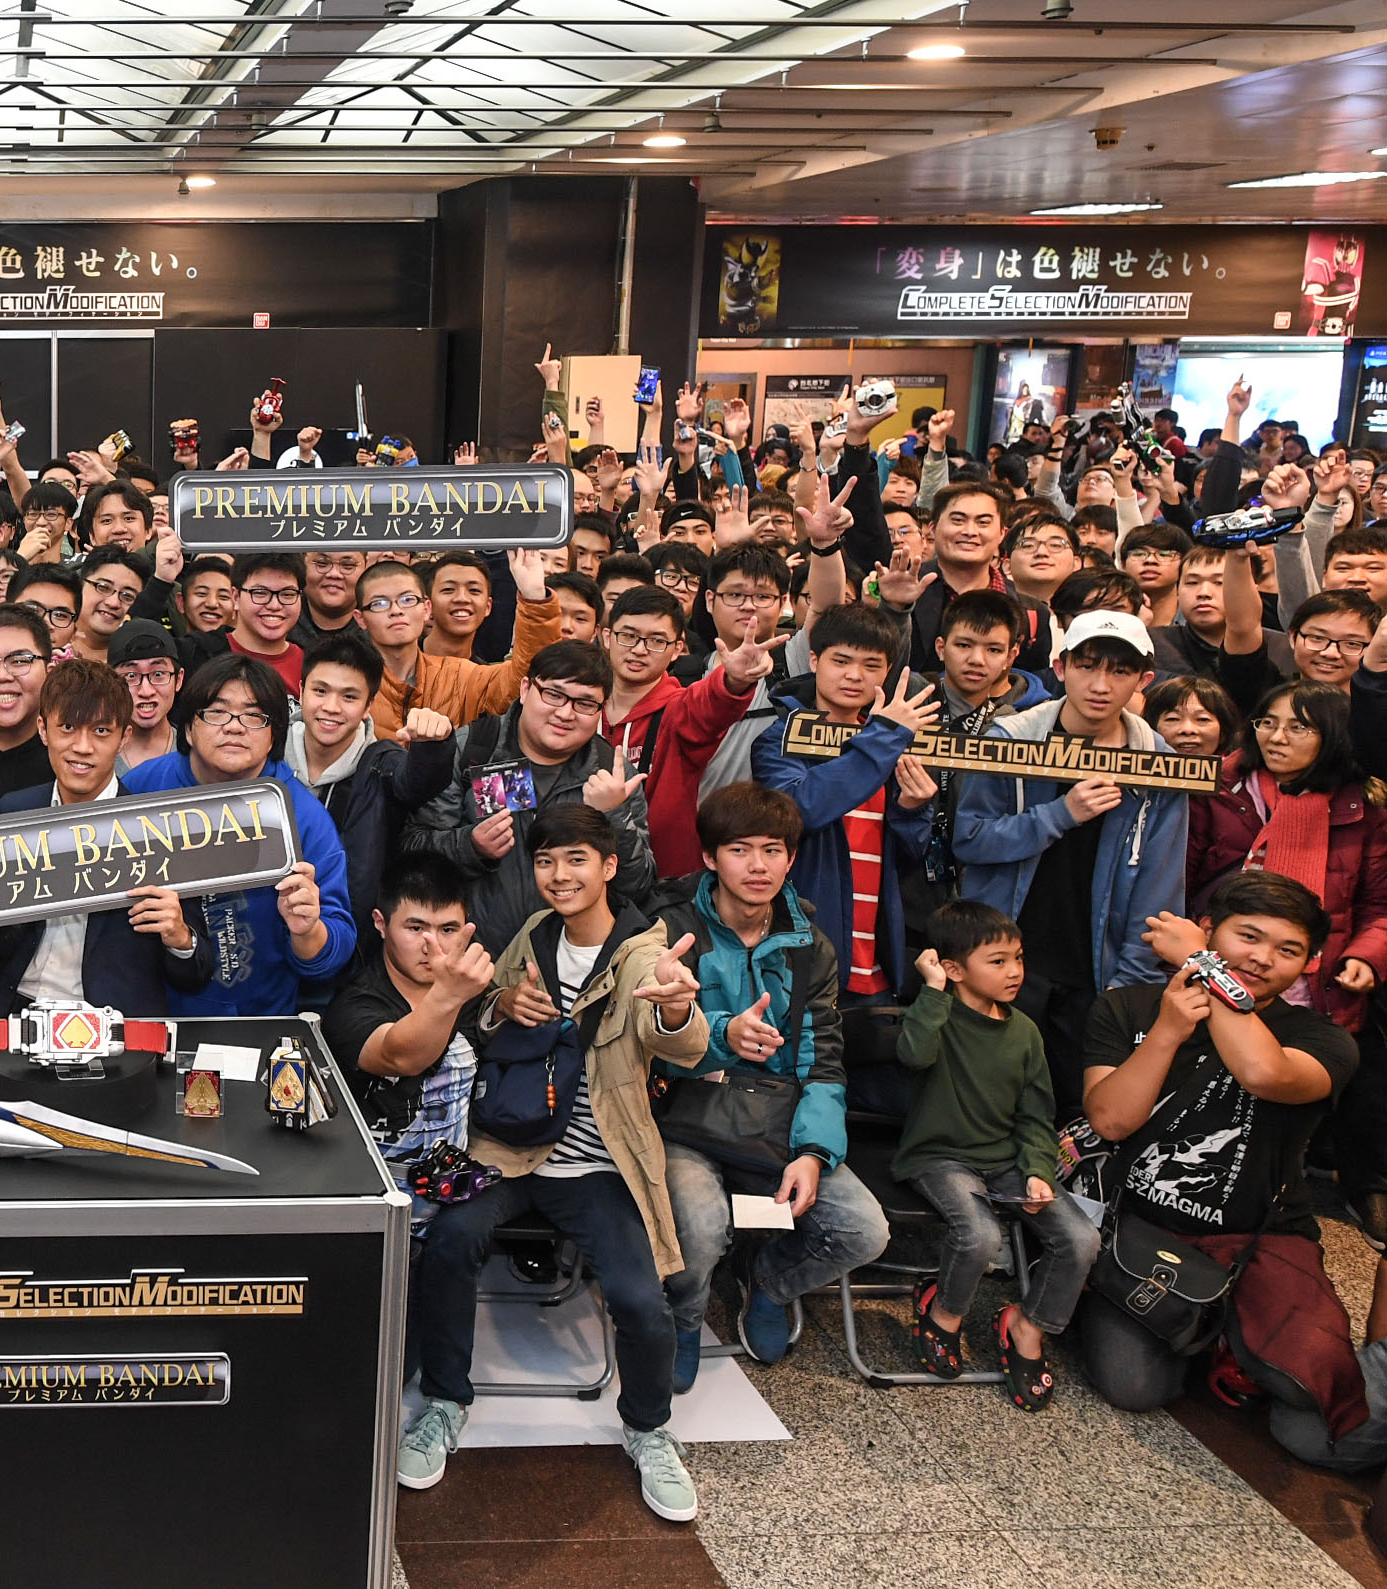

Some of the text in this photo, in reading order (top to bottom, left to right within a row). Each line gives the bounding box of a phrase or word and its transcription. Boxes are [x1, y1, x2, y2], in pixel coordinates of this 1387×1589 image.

[192, 480, 548, 519] PREMIUM BANDAI
[270, 517, 465, 538] プレミアム バンダイ
[69, 800, 269, 867] BANDAI
[73, 857, 171, 895] バンダイ
[98, 1362, 217, 1388] BANDAI
[8, 1387, 156, 1403] プレミアム バンダイ
